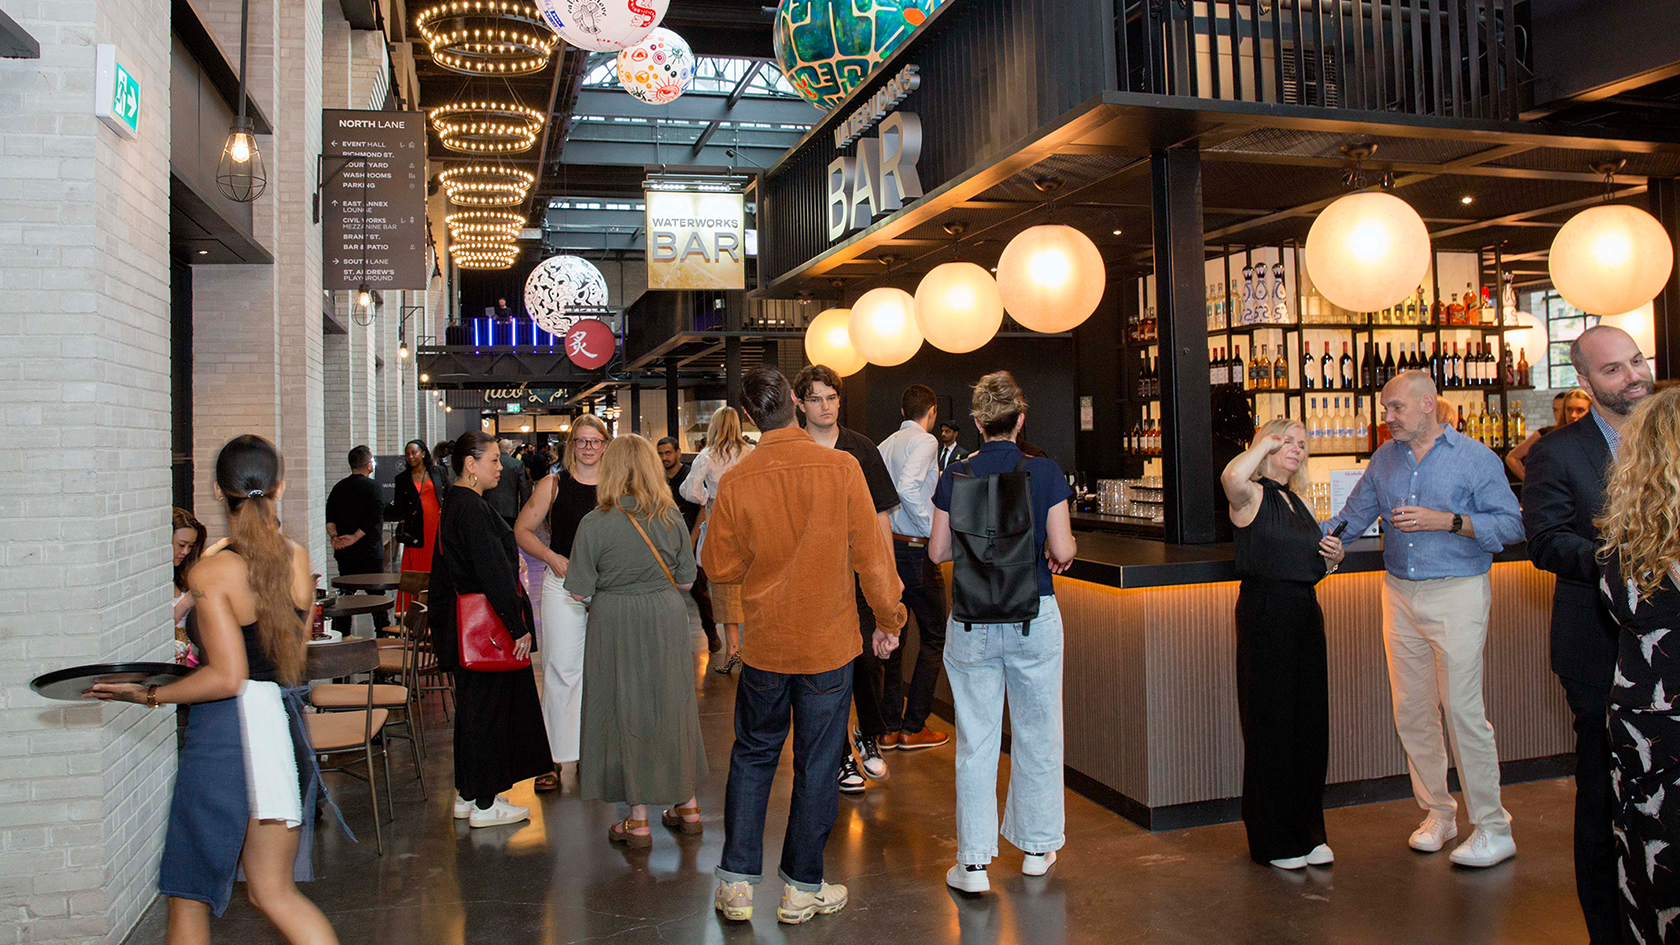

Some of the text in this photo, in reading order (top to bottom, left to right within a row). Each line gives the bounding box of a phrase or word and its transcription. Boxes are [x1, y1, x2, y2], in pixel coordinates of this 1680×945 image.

[834, 64, 920, 149] WATERWORKS
[338, 119, 405, 129] NORTH LANE
[828, 111, 923, 242] BAR
[652, 218, 739, 228] WATERWORKS
[652, 231, 739, 263] BAR
[568, 331, 598, 358] 炙
